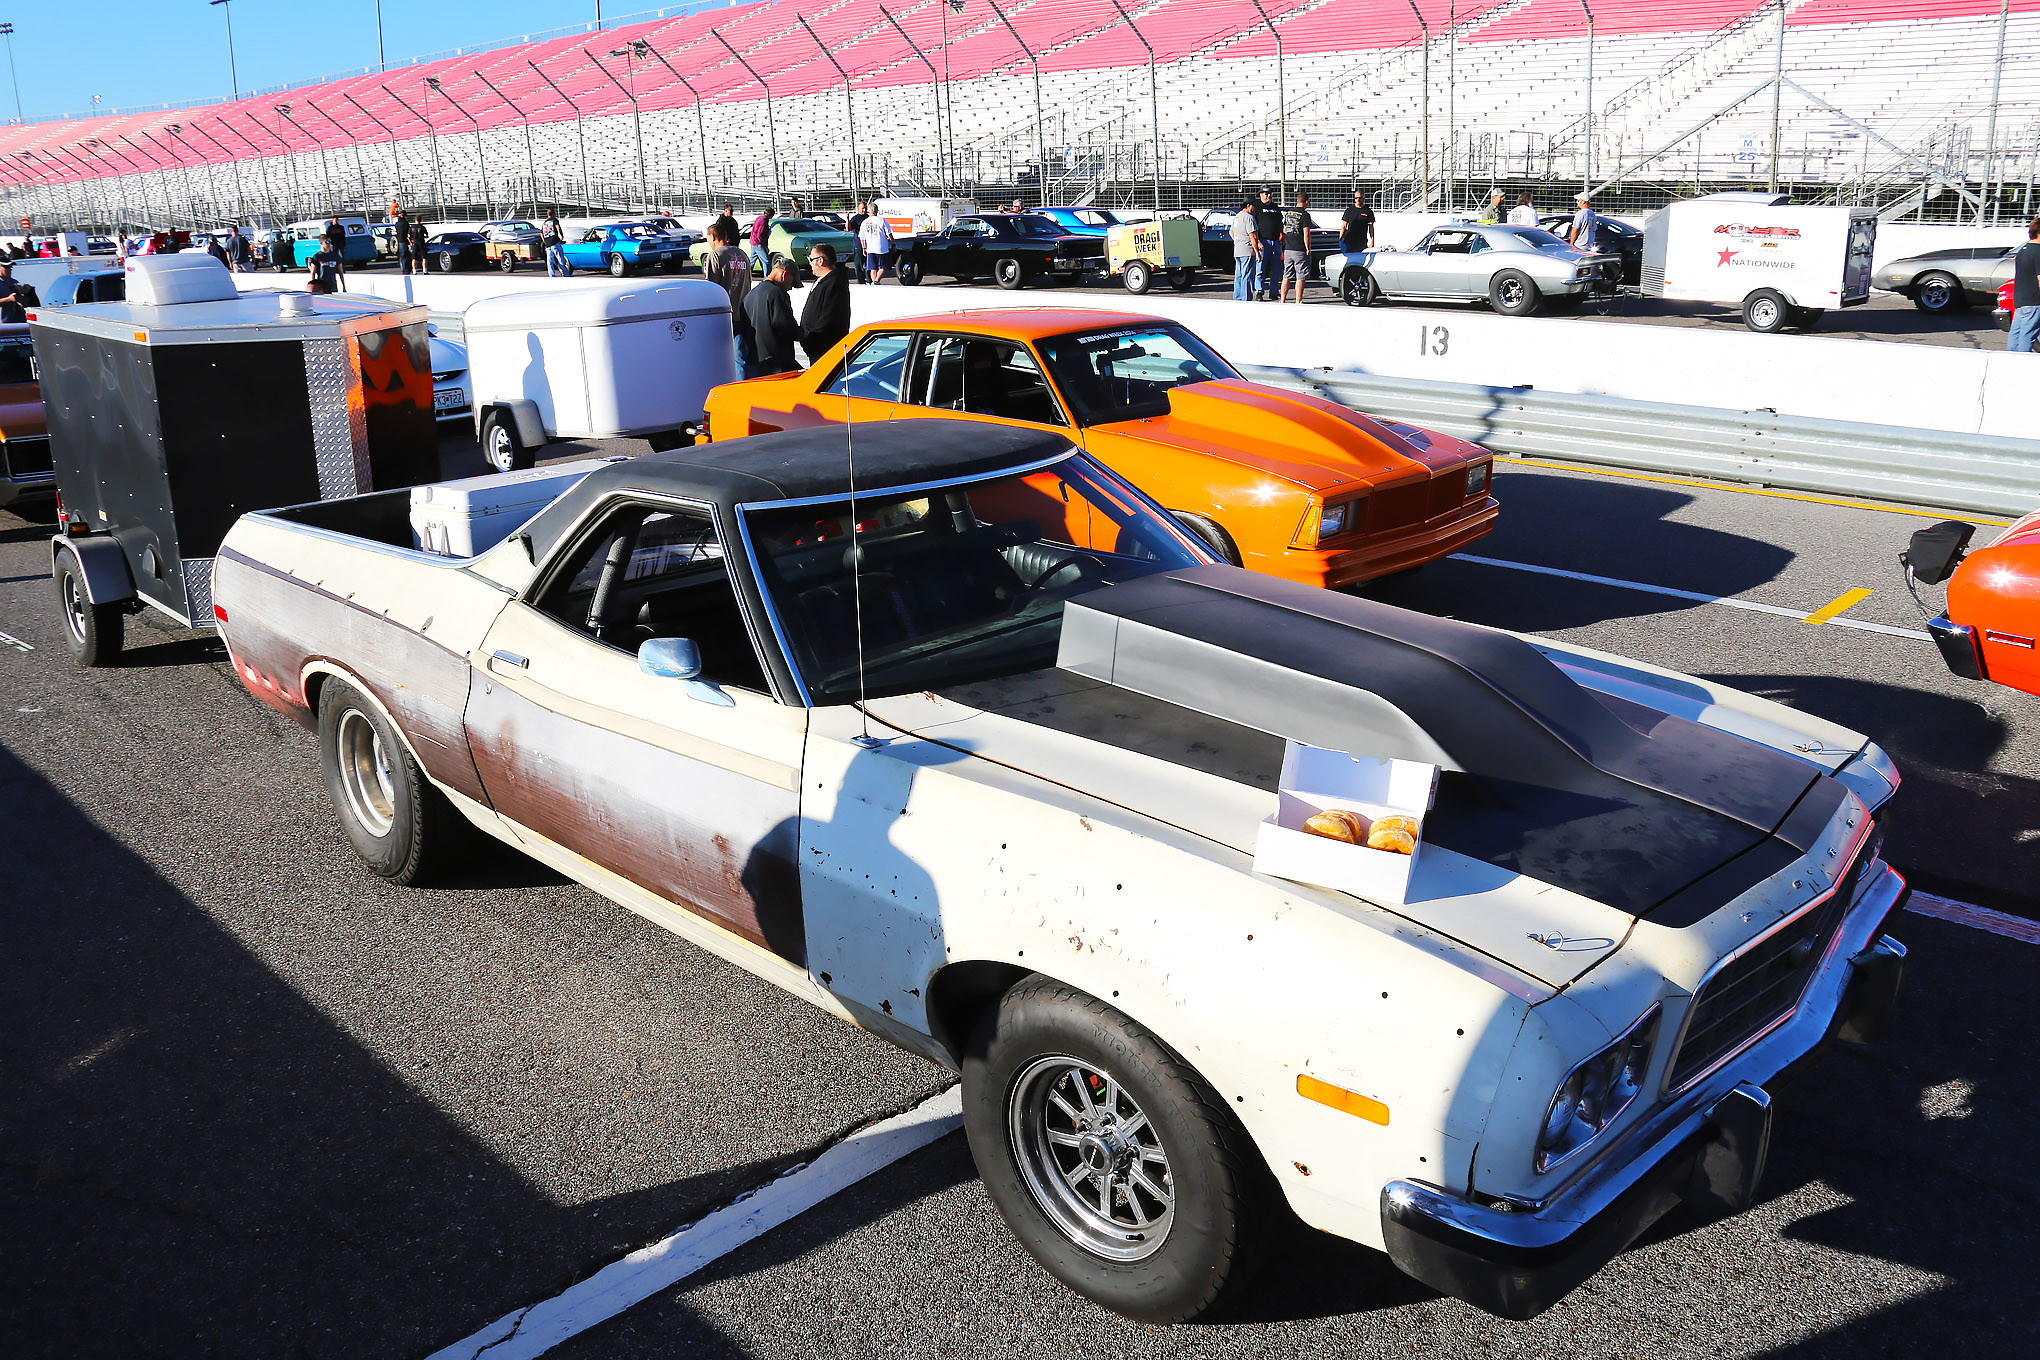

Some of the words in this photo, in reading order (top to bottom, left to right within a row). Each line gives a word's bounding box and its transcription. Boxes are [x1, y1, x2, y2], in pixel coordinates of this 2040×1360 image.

[1739, 152, 1756, 160] 25
[1135, 243, 1157, 253] WEEK
[1731, 258, 1796, 269] NATIONWIDE
[1420, 325, 1450, 356] 13
